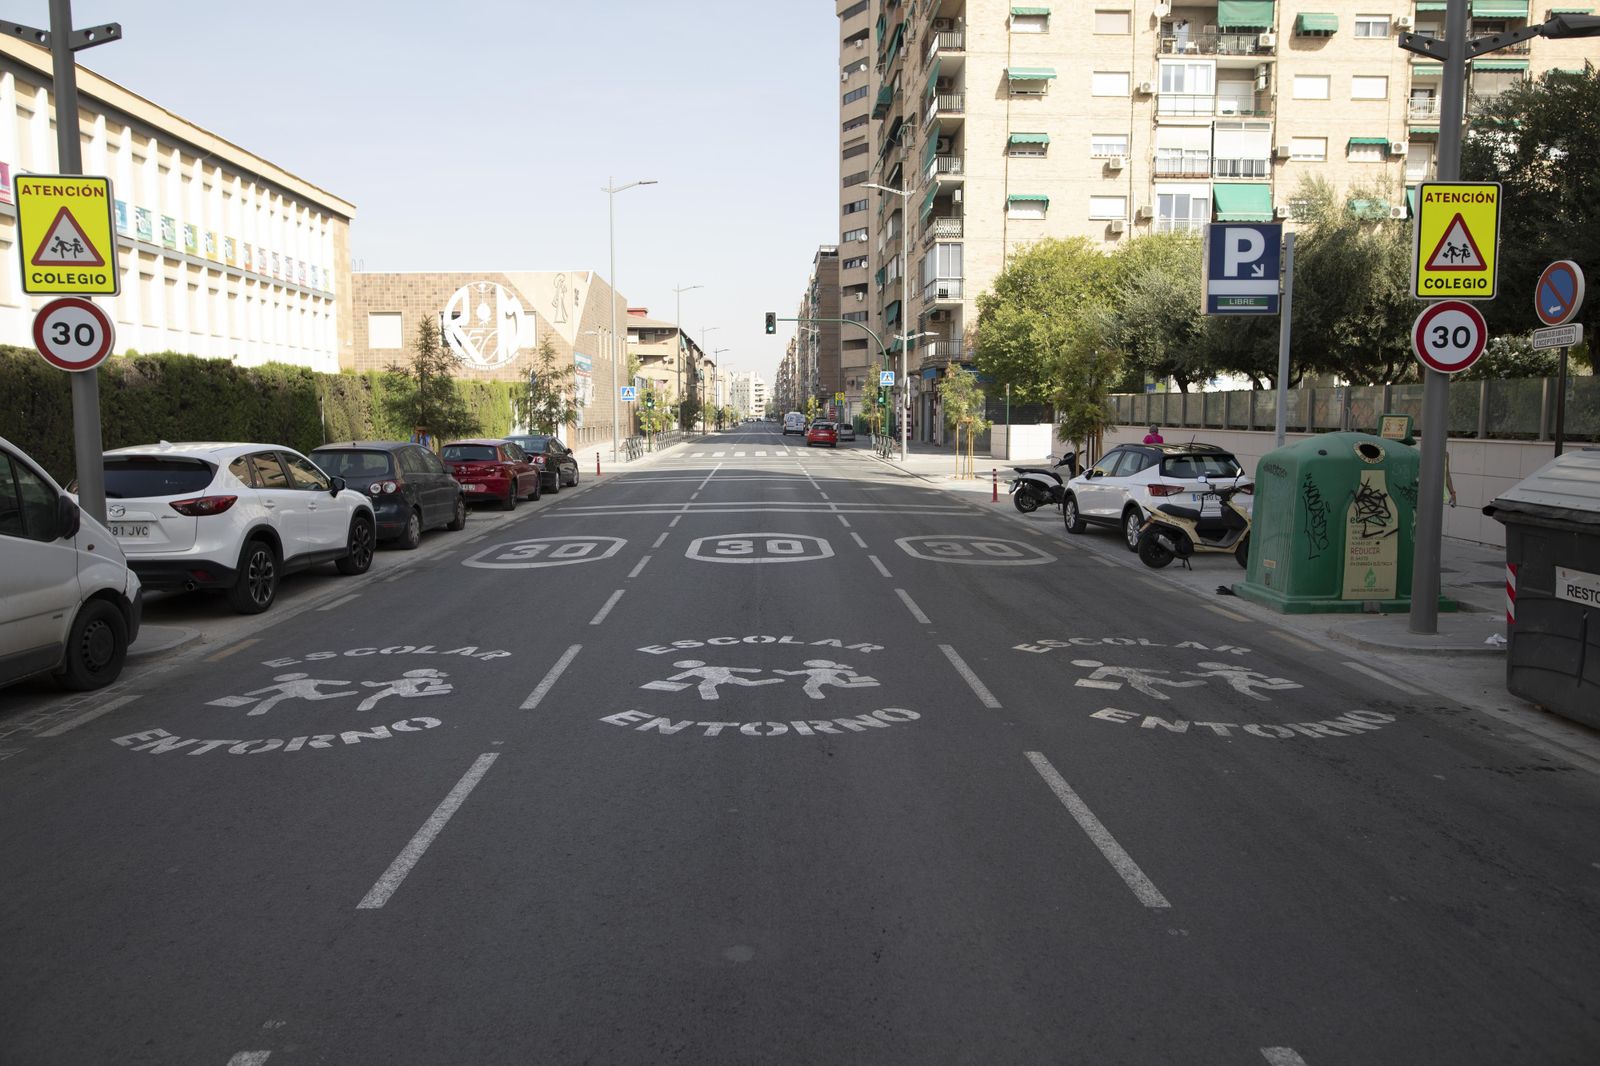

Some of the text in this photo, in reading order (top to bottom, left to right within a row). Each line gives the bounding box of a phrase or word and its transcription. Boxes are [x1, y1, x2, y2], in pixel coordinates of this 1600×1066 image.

[22, 184, 104, 198] ATENCIÓN
[1425, 191, 1495, 204] ATENCIÓN
[1224, 228, 1265, 277] P
[32, 272, 107, 285] COLEGIO
[1424, 278, 1487, 289] COLEGIO
[51, 321, 95, 347] 30
[1431, 325, 1471, 349] 30
[128, 526, 149, 536] JVC
[496, 542, 598, 560] 30
[716, 540, 805, 554] 30
[923, 541, 1025, 557] 30
[1350, 547, 1381, 555] REDUCIR
[636, 635, 885, 654] ESCOLAR
[1012, 637, 1252, 655] ESCOLAR
[262, 645, 512, 667] ESCOLAR
[598, 705, 921, 736] ENTORNO
[1090, 706, 1396, 739] ENTORNO
[110, 716, 442, 756] ENTORNO
